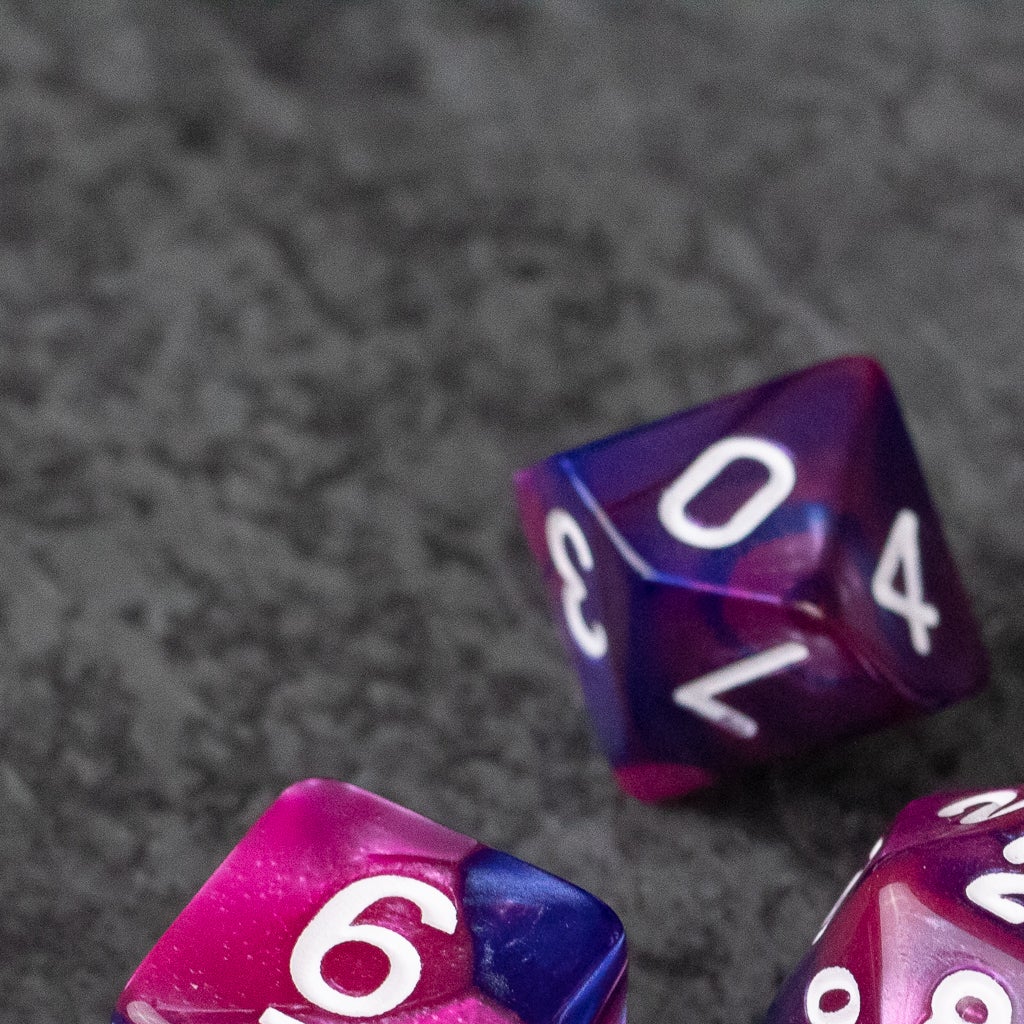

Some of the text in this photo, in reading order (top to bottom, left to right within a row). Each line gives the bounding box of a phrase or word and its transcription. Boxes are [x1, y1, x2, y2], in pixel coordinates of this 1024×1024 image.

[659, 436, 797, 549] 0
[545, 508, 608, 660] 3
[871, 508, 940, 656] 4
